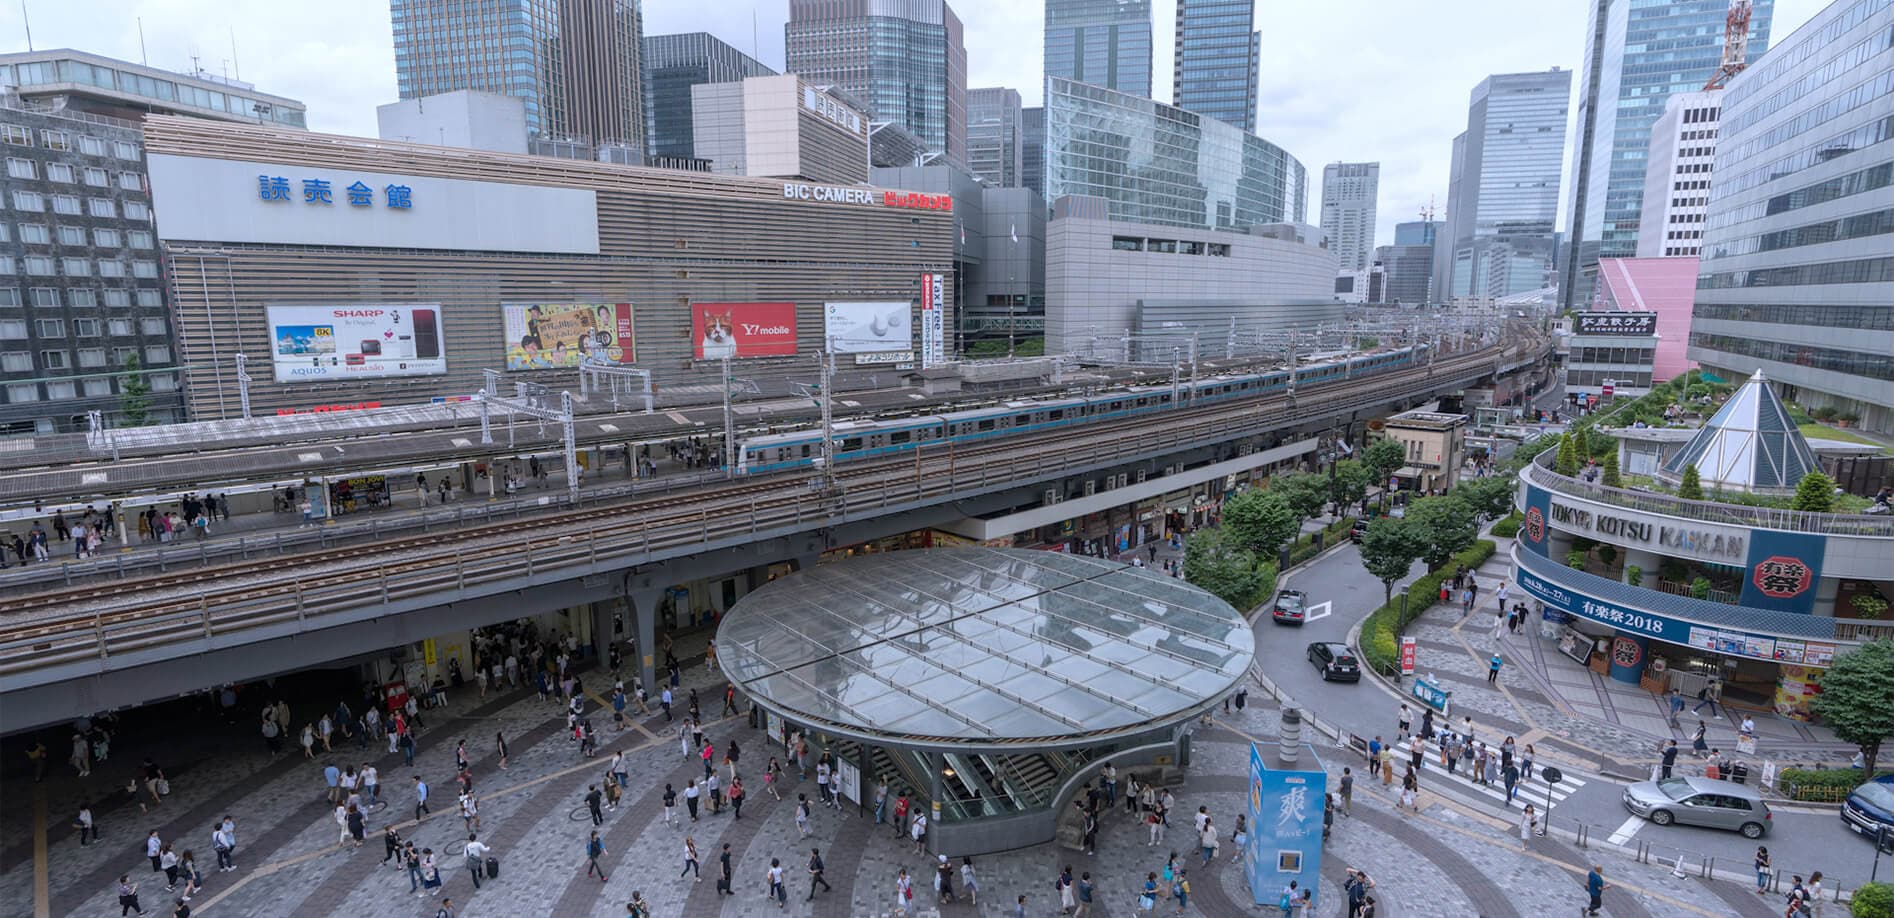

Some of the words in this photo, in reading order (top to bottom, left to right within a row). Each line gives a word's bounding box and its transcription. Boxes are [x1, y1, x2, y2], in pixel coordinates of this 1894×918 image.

[258, 175, 412, 208] 読売会館
[783, 183, 809, 199] BIC
[813, 186, 874, 204] CAMERA
[933, 277, 943, 300] Tax
[333, 310, 384, 318] SHARP
[933, 303, 943, 330] Free
[316, 328, 331, 336] 8K
[291, 367, 327, 376] AQUOS
[1551, 503, 1592, 530] TOKYO
[1596, 514, 1651, 541] KOTSU
[1659, 526, 1743, 558] KAIKAN
[1762, 561, 1805, 577] 有楽
[1761, 574, 1801, 593] 祭
[1582, 600, 1663, 634] 有楽祭2018
[1278, 786, 1308, 826] 爽
